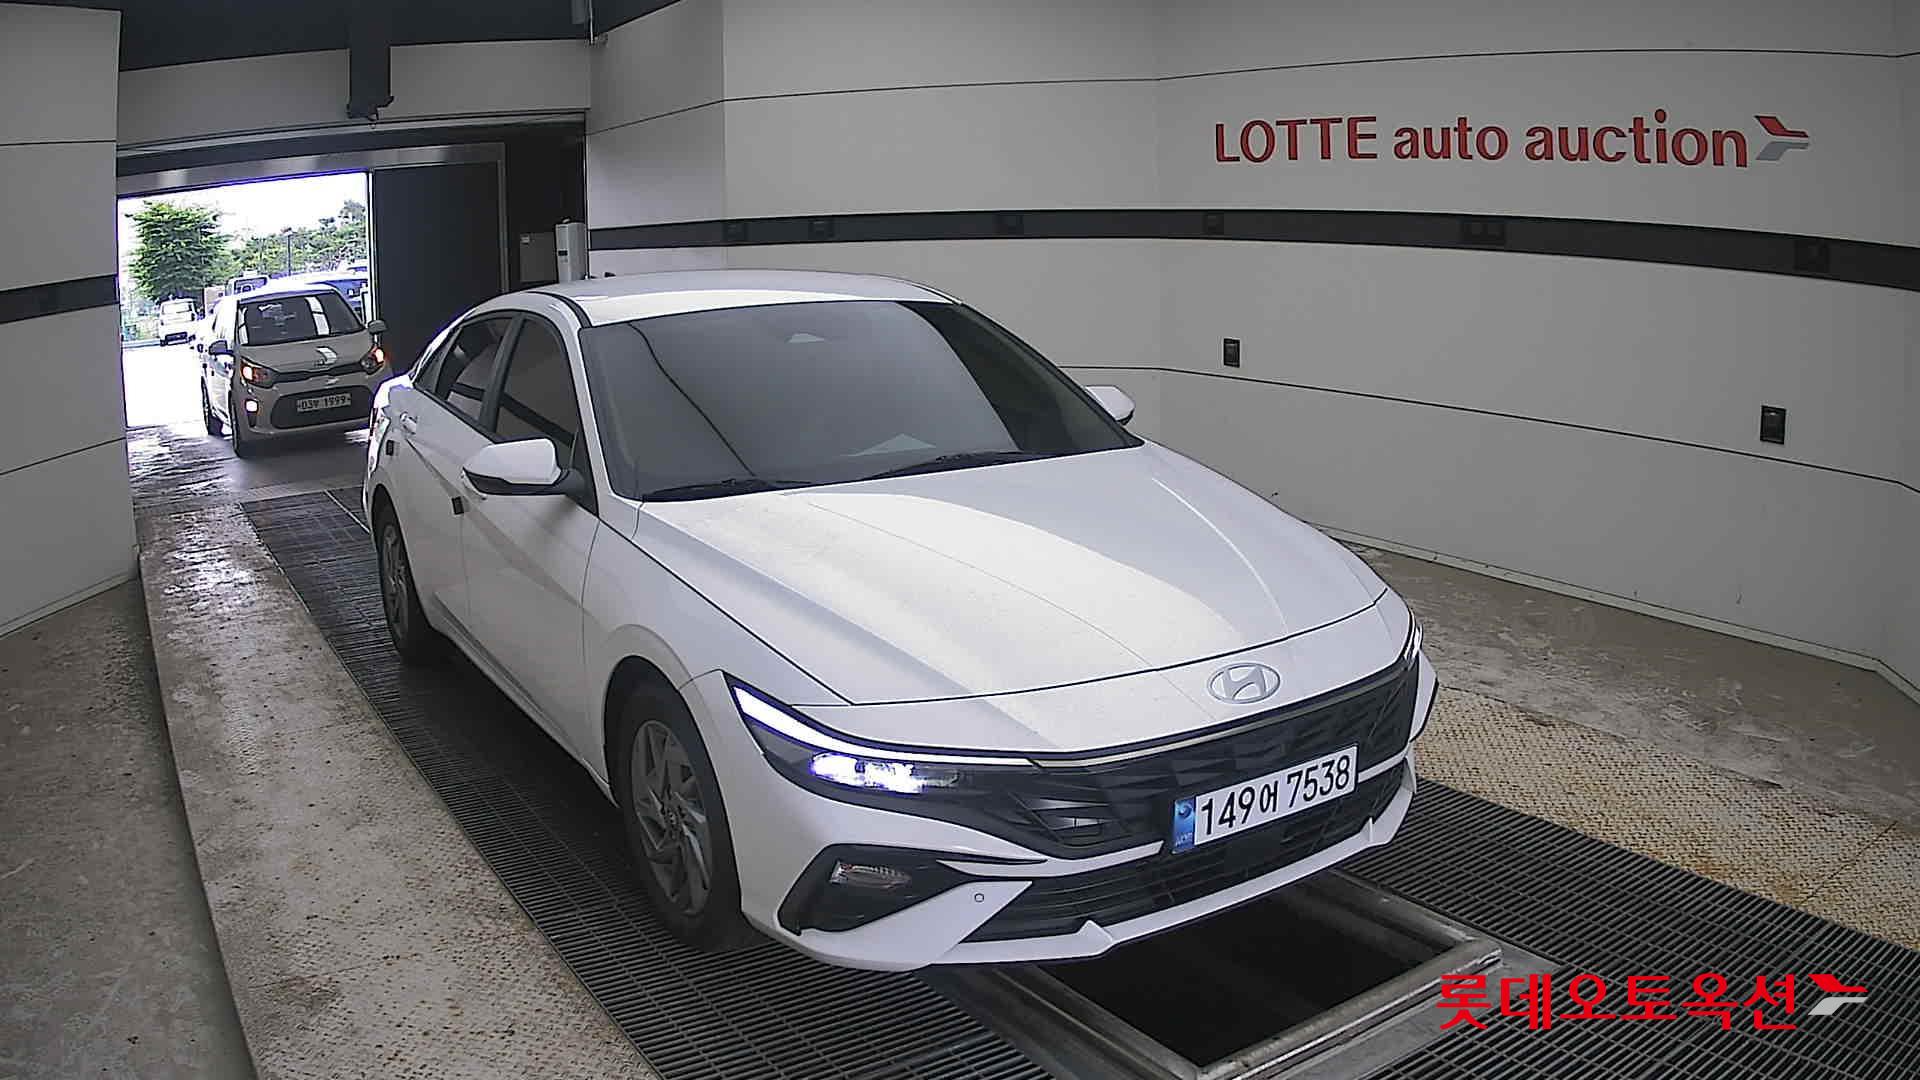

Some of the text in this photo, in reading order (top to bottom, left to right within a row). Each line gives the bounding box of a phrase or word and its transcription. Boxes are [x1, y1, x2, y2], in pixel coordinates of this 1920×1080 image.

[1215, 109, 1748, 168] LOTTE auto auction
[1201, 755, 1350, 835] 149어 7538
